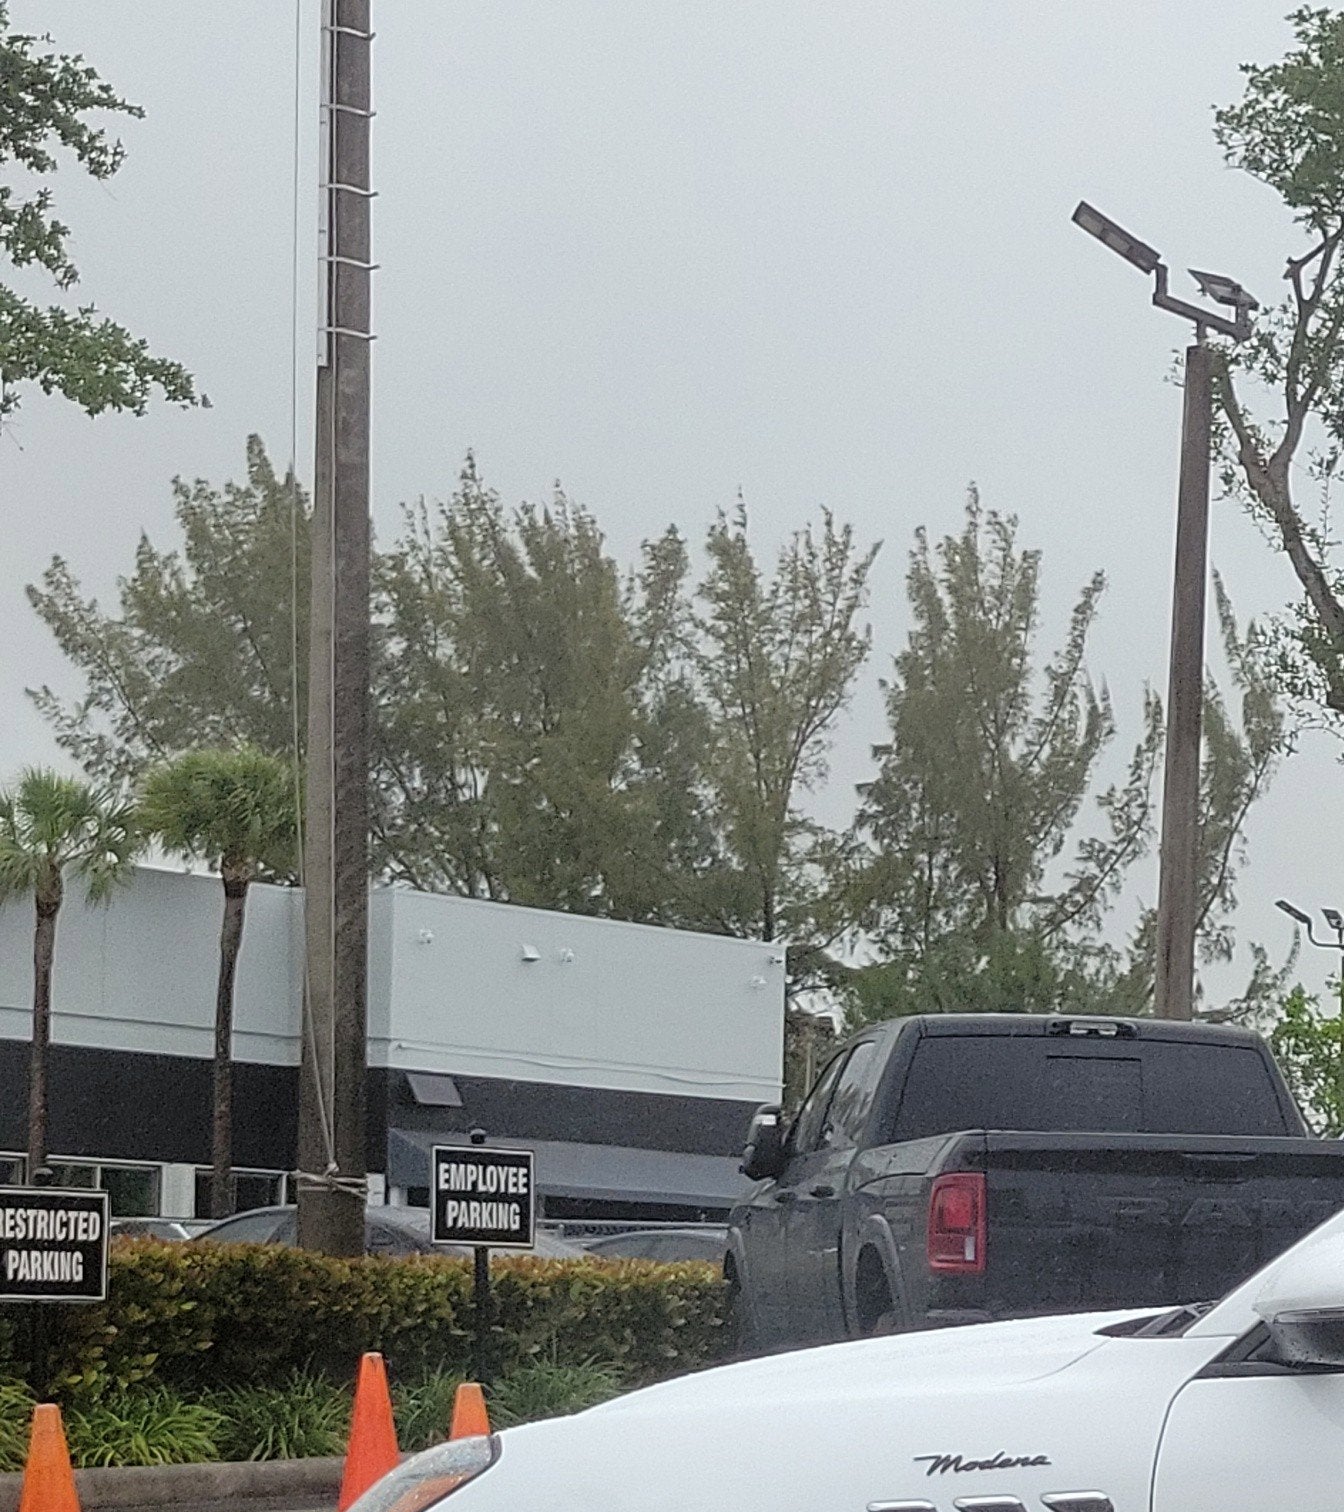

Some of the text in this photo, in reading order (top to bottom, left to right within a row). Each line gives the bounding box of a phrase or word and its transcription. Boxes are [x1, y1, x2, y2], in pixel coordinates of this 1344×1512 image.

[438, 1161, 528, 1193] EMPLOYEE
[445, 1200, 520, 1230] PARKING
[8, 1250, 83, 1281] PARKING
[913, 1451, 1052, 1476] Modena
